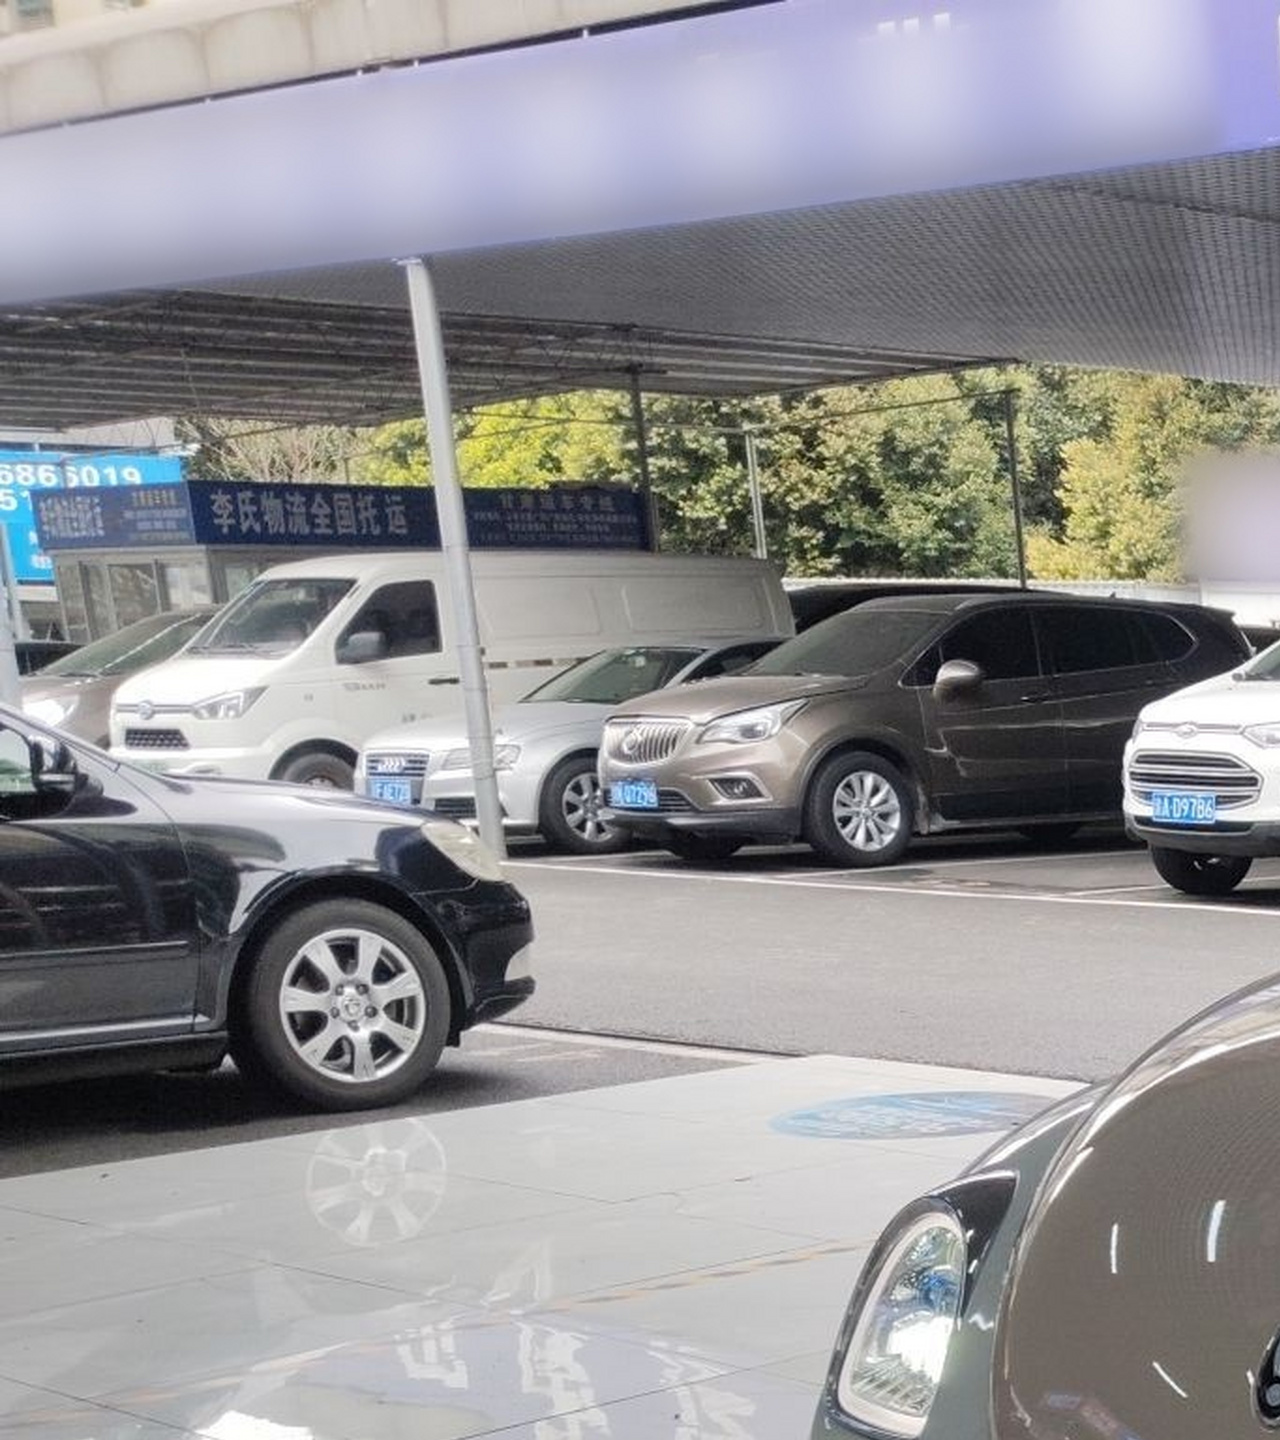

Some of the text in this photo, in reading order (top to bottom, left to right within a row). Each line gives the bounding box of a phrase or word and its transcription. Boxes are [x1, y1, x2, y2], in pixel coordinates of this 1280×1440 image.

[210, 489, 408, 535] 李氏物流全国托运
